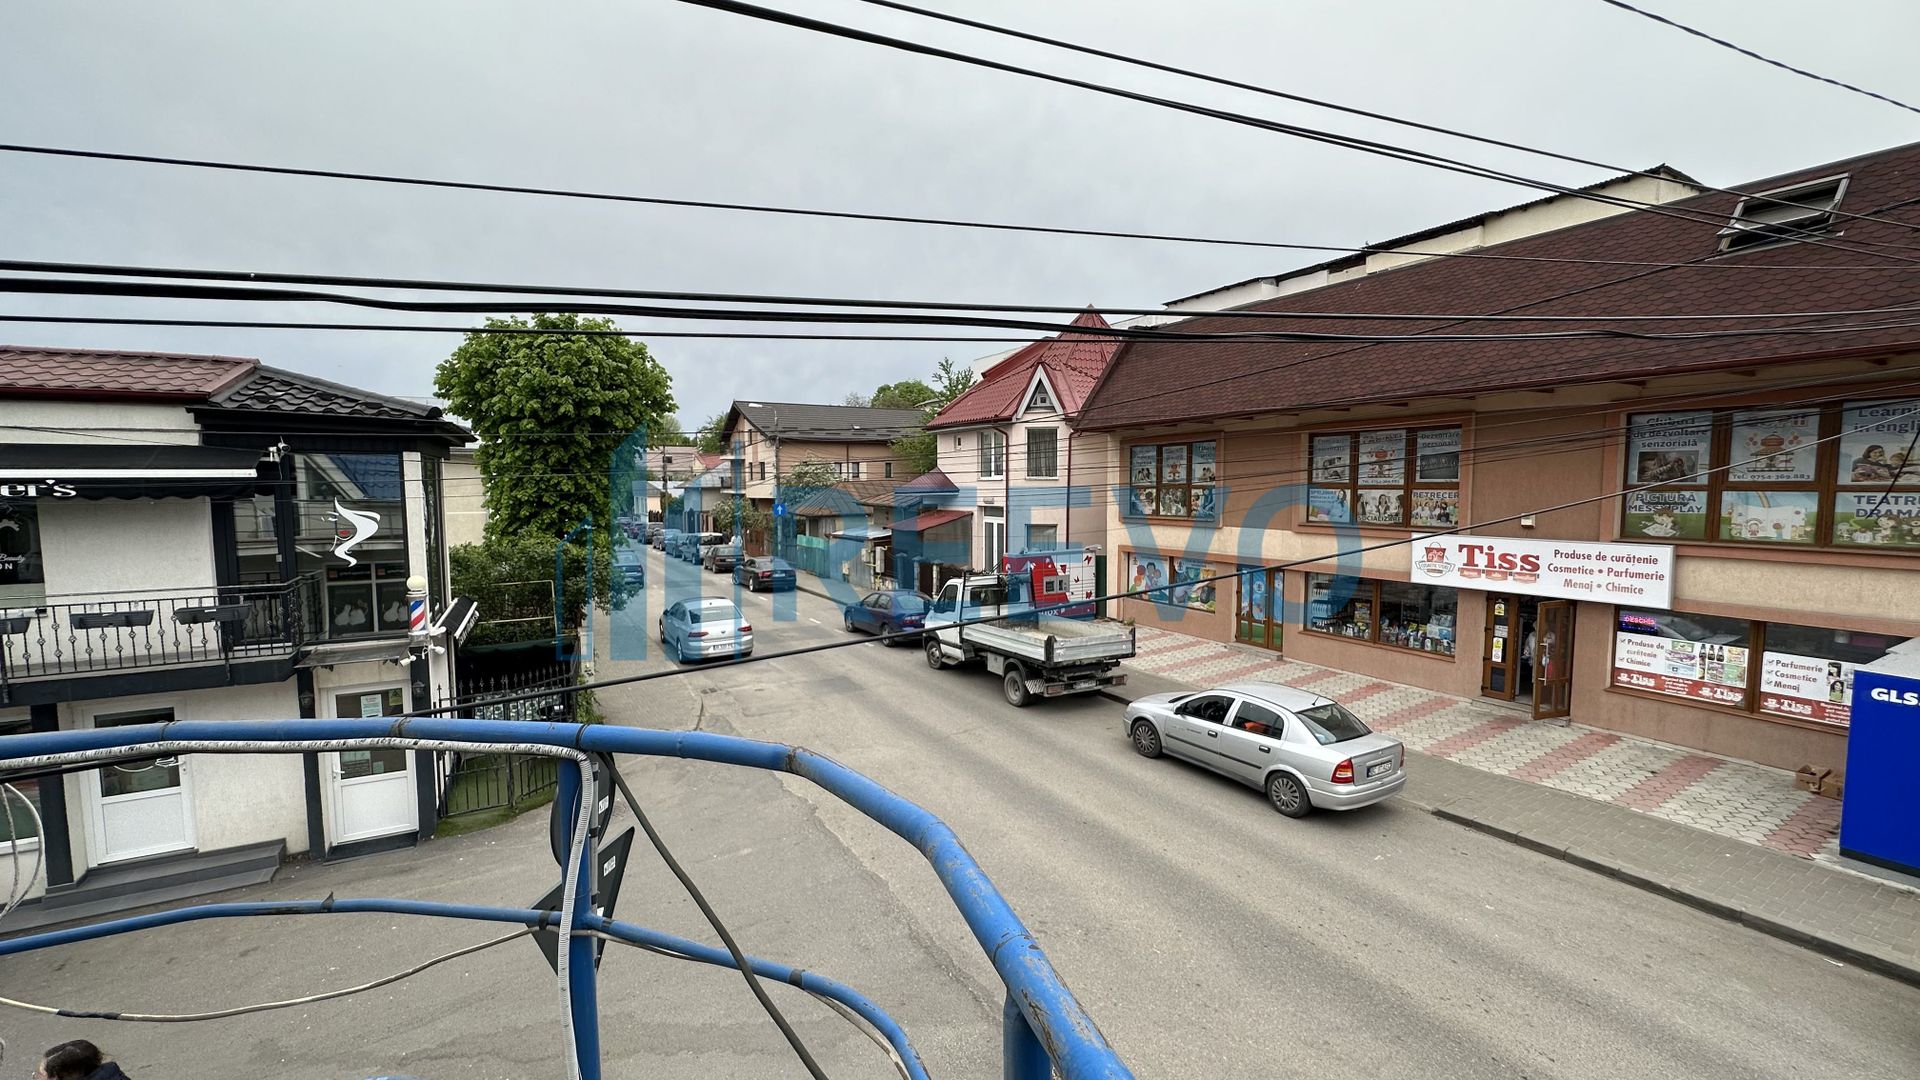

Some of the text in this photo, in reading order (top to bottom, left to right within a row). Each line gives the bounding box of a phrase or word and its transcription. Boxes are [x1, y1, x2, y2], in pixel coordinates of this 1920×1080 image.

[1858, 404, 1920, 417] Learni
[1641, 438, 1698, 449] senzorială
[1853, 495, 1920, 506] TEATR
[1458, 544, 1540, 572] Tiss
[1554, 549, 1659, 566] Produse de curățenie
[1547, 563, 1665, 581] Cosmetice Parfumerie
[1563, 578, 1644, 595] Menaj Chimice
[1656, 642, 1665, 650] de
[1626, 657, 1651, 667] Chimice
[1776, 659, 1823, 673] Parfumerie
[1630, 673, 1656, 687] Tiss
[1775, 670, 1818, 683] Cosmetice
[1774, 681, 1801, 692] Menaj
[1714, 687, 1743, 701] Tiss
[1781, 698, 1812, 715] Tiss
